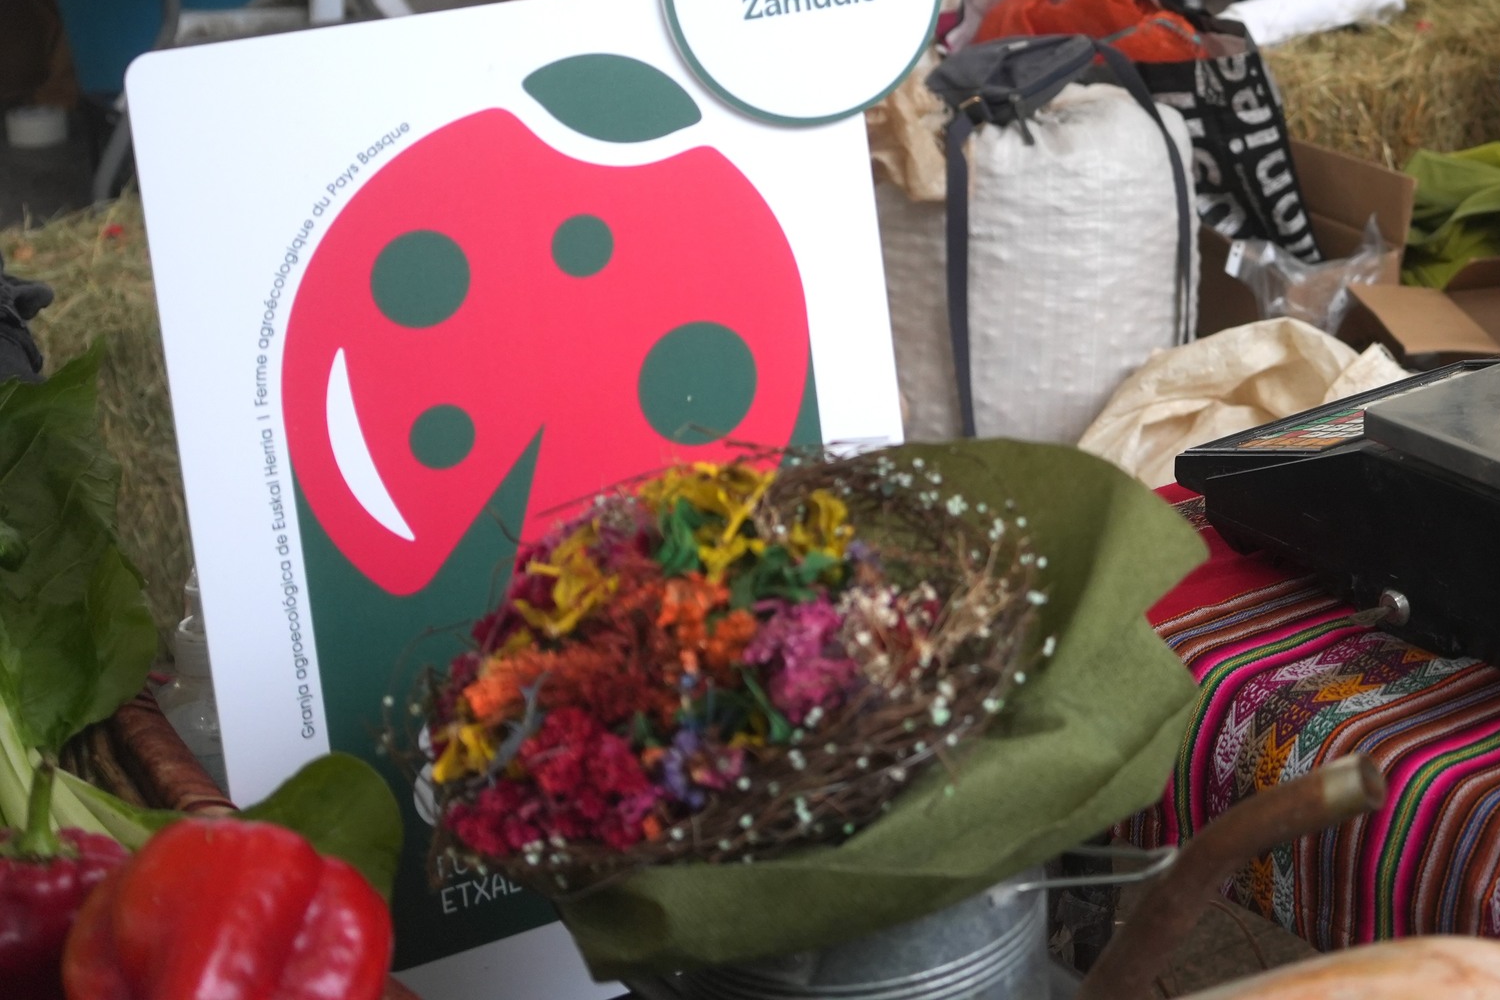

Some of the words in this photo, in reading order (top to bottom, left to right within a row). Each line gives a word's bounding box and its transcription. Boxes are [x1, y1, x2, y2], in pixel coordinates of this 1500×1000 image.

[356, 120, 411, 166] Basque
[326, 162, 360, 198] Pays
[311, 195, 331, 219] du
[254, 353, 268, 407] Ferme
[259, 428, 280, 480] Herria
[265, 481, 286, 532] Euskal
[275, 534, 289, 556] de
[298, 683, 315, 740] Granja
[441, 873, 523, 914] ETXAL
